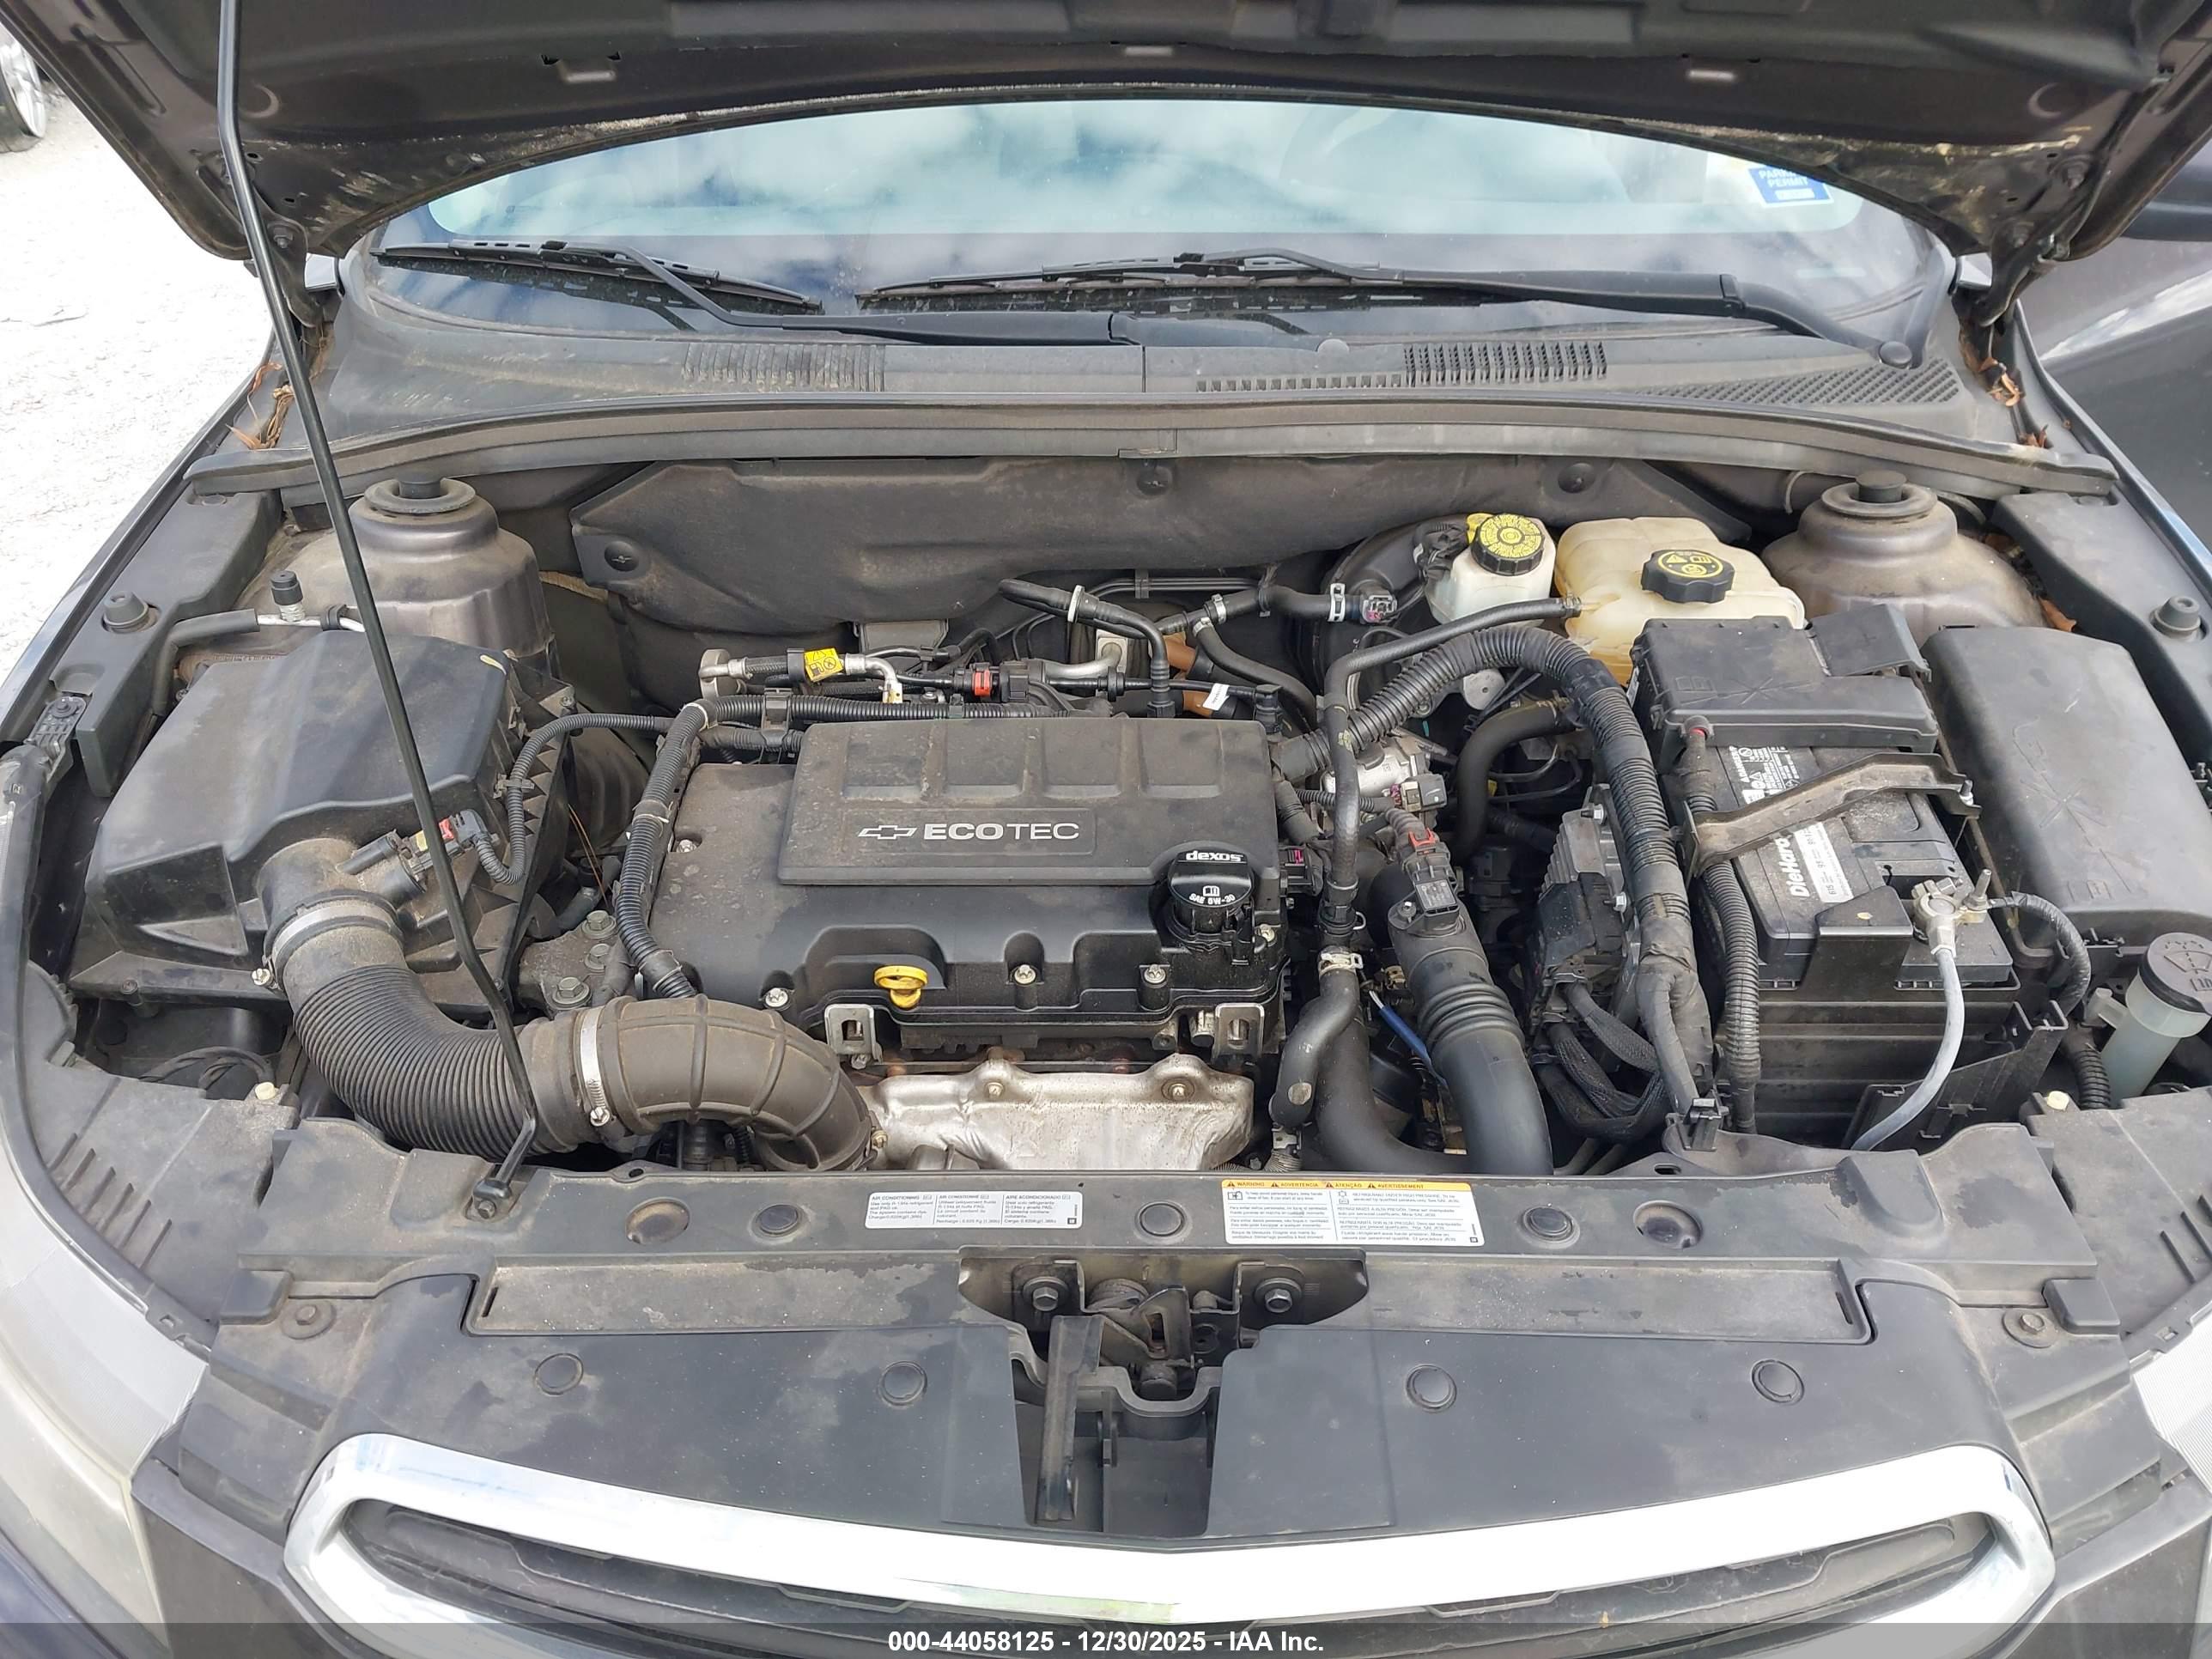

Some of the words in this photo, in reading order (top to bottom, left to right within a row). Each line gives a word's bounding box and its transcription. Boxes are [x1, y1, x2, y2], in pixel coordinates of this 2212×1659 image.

[1766, 176, 1808, 188] PERMIT
[923, 822, 1080, 841] ECOTEC
[1185, 850, 1244, 862] dexos
[1188, 893, 1206, 904] SAE
[1207, 893, 1236, 905] 5W-30
